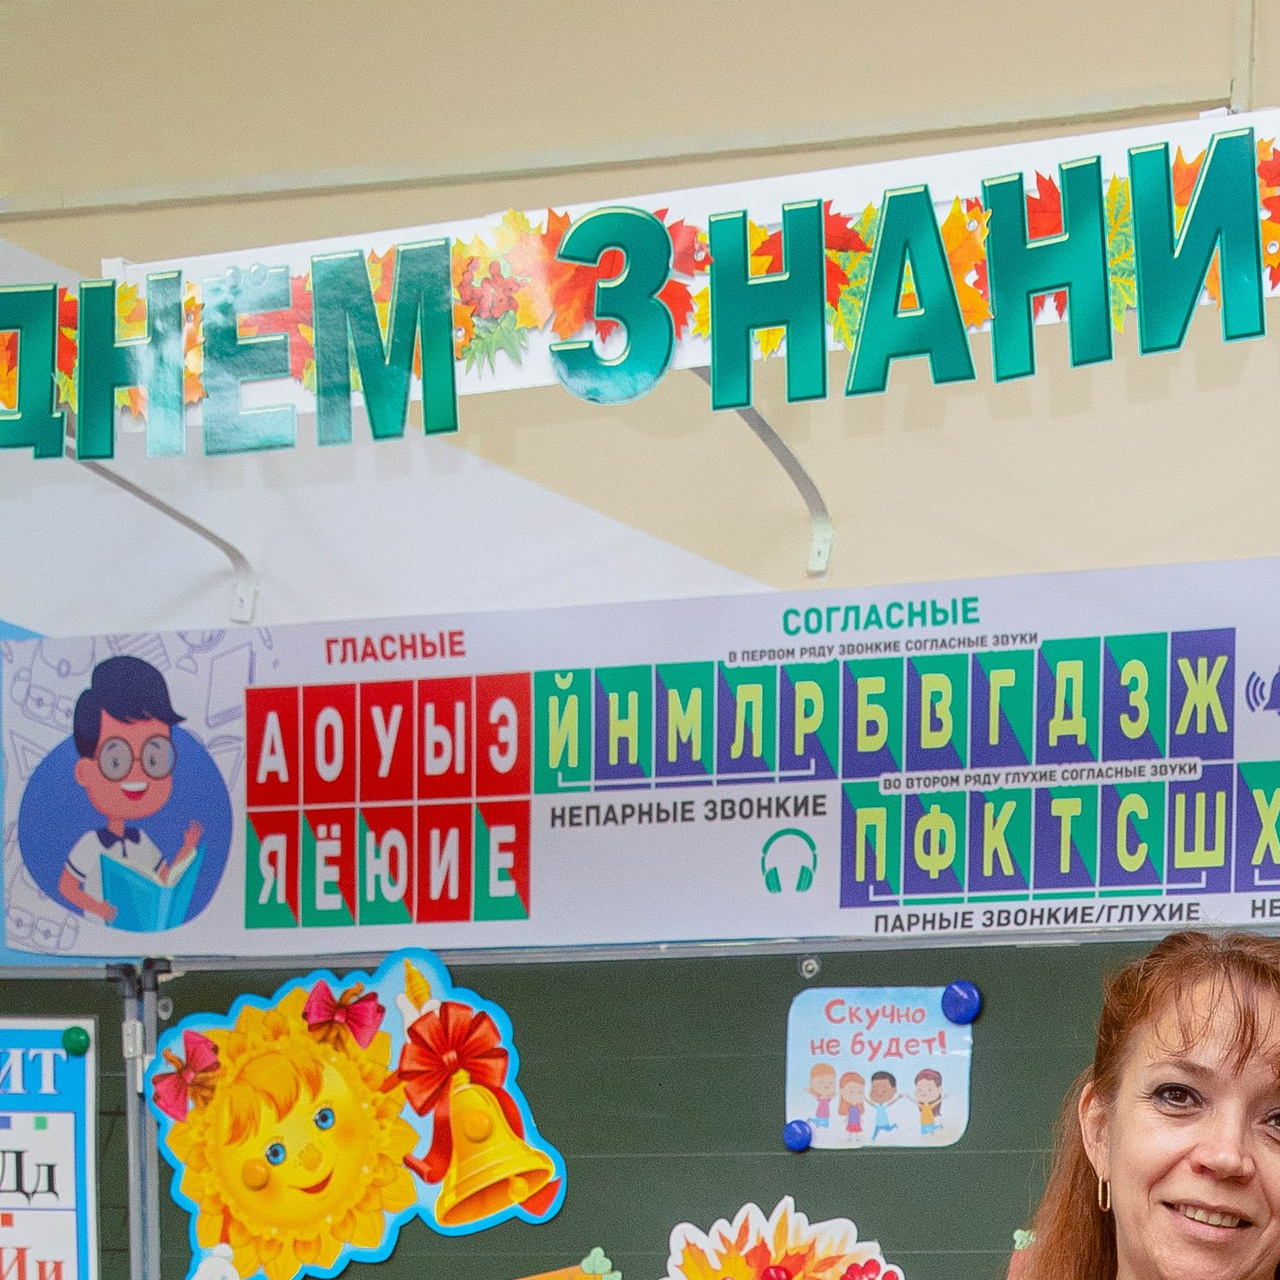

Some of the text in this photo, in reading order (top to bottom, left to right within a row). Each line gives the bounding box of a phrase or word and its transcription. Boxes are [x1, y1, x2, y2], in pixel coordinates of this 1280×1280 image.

[782, 597, 980, 636] СОГЛАСНЫЕ
[325, 630, 466, 665] ГЛАСНЫЕ
[729, 632, 1038, 663] В ПЕРВОМ РЯДУ ЗВОНКИЕ СОГЛАСНЫЕ ЗВУКИ
[548, 654, 1228, 769] Й Н М Л Р Б В Г Д З Ж
[256, 696, 518, 784] А О У Ы Э
[883, 762, 1198, 791] ВО ВТОРОМ РЯДУ ГЛУХИЕ СОГЛАСНЫЕ ЗВУКИ
[549, 794, 828, 830] НЕПАРНЫЕ ЗВОНКИЕ
[854, 807, 887, 882] П
[914, 804, 956, 880] Ф
[983, 801, 1017, 877] К
[1051, 797, 1082, 874] Т
[1116, 793, 1149, 873] С
[1174, 790, 1226, 869] Ш
[257, 824, 515, 912] Я Ё Ю И Е
[875, 902, 1200, 934] ПАРНЫЕ ЗВОНКИЕ/ГЛУХИЕ
[825, 999, 925, 1030] Скучно
[809, 1030, 948, 1062] не будет!
